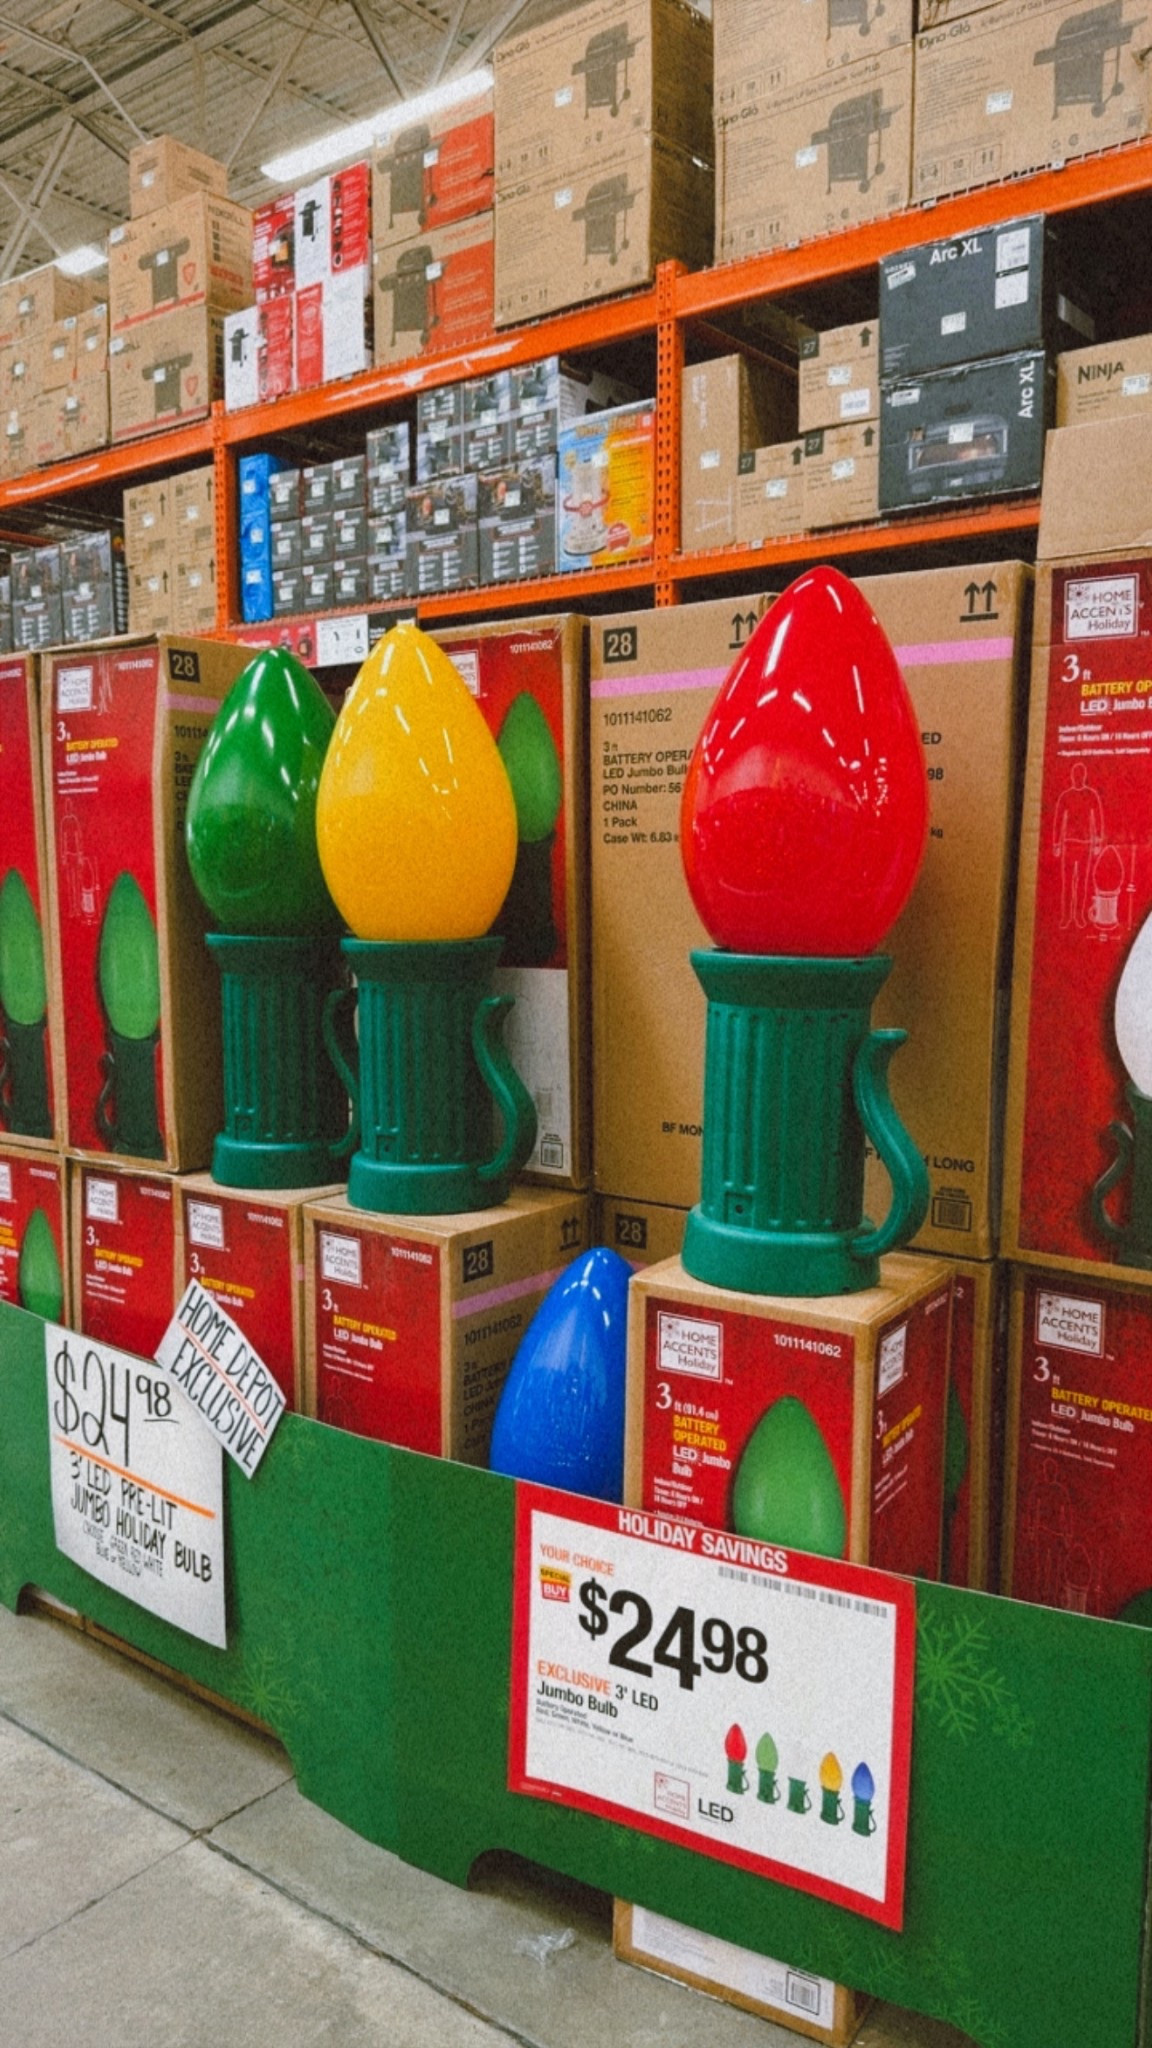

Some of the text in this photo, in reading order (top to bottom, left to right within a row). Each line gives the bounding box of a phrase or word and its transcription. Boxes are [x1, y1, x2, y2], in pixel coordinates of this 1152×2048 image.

[929, 238, 982, 266] Arc XL
[803, 341, 816, 354] 27
[1078, 361, 1125, 385] NINJA
[1018, 360, 1034, 419] Arc XL
[807, 439, 820, 451] 27
[740, 458, 752, 468] 27
[1093, 590, 1132, 603] HOME
[1070, 604, 1132, 620] ACCENTS
[1089, 617, 1131, 632] Holiday
[607, 633, 633, 657] 28
[172, 654, 195, 677] 28
[1062, 654, 1080, 682] 3
[1081, 681, 1134, 696] BATTERY
[1080, 697, 1146, 713] LED Jumbo
[604, 708, 673, 726] 1011141062
[57, 721, 66, 741] 3
[604, 742, 611, 752] 3
[604, 752, 652, 766] BATTERY
[604, 767, 625, 779] LED
[627, 766, 664, 778] Jumbo
[604, 784, 618, 795] PO
[621, 783, 666, 795] Number:
[604, 800, 638, 812] CHINA
[612, 817, 637, 828] Pack
[604, 834, 629, 845] Case
[934, 1157, 975, 1173] LONG
[86, 1225, 95, 1246] 3
[618, 1219, 643, 1243] 28
[190, 1252, 199, 1273] 3
[467, 1249, 489, 1275] 28
[321, 1288, 332, 1311] 3
[333, 1314, 361, 1332] BATTERY
[1062, 1308, 1099, 1324] HOME
[464, 1314, 523, 1346] 1011141062
[1041, 1316, 1099, 1337] ACCENTS
[681, 1330, 717, 1345] HOME
[773, 1333, 842, 1358] 1011141062
[1057, 1331, 1098, 1350] Holiday
[178, 1284, 284, 1430] HOME DEPOT
[662, 1341, 718, 1361] ACCENTS
[677, 1354, 717, 1373] Holiday
[1033, 1356, 1050, 1382] 3
[464, 1383, 483, 1401] LED
[656, 1382, 672, 1410] 3
[1051, 1386, 1099, 1409] BATTERY
[170, 1336, 265, 1469] EXCLUSIVE
[673, 1415, 720, 1435] BATTERY
[1050, 1402, 1135, 1433] LED Jumbo Bulb
[673, 1429, 727, 1452] OPERATED
[672, 1445, 732, 1470] LED Jumbo
[672, 1461, 693, 1478] Bulb
[87, 1458, 112, 1496] LED
[121, 1477, 178, 1531] PRE-LIT
[70, 1482, 213, 1583] JUMBO HOLIDAY BULB
[618, 1510, 697, 1550] HOLIDAY
[701, 1532, 789, 1575] SAVINGS
[540, 1543, 615, 1577] YOUR CHOICE
[540, 1567, 571, 1581] SPECIAL
[543, 1583, 567, 1596] BUY
[537, 1659, 659, 1712] EXCLUSIVE 3' LED
[536, 1681, 619, 1719] Jumbo Bulb
[698, 1797, 734, 1823] LED
